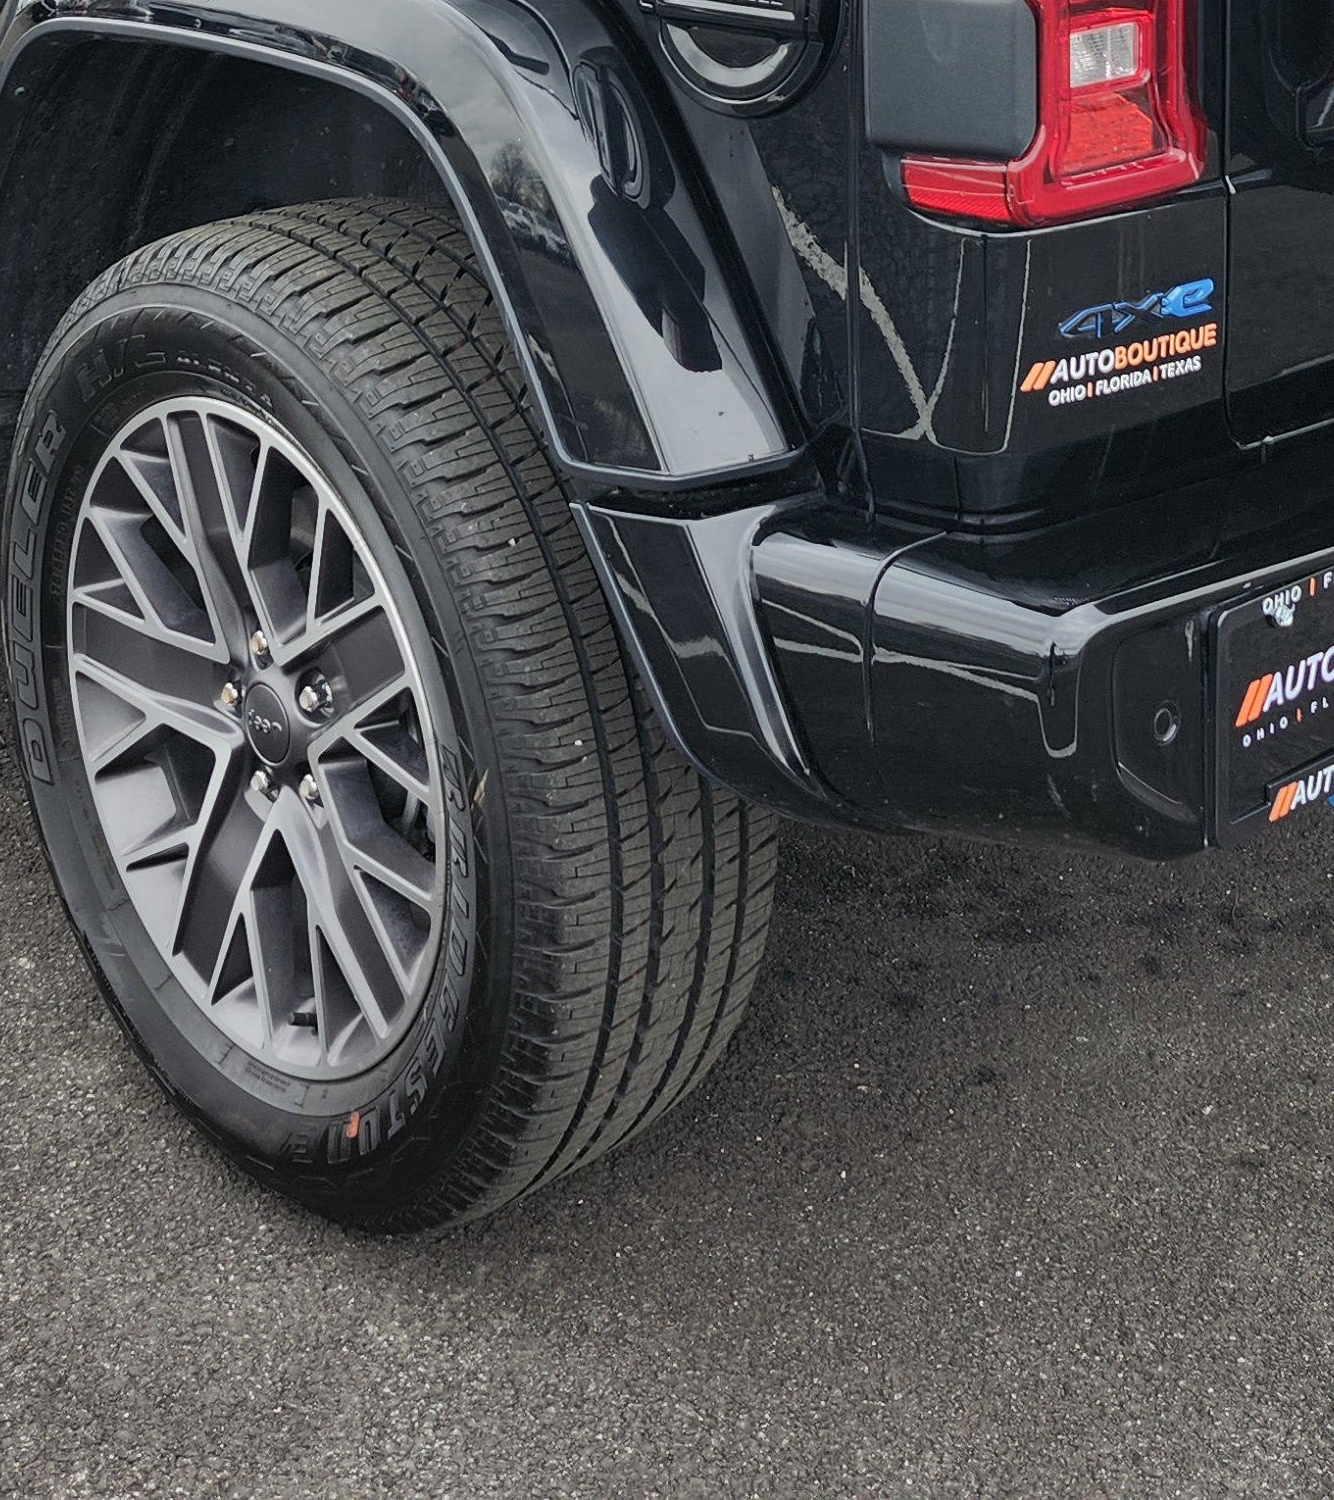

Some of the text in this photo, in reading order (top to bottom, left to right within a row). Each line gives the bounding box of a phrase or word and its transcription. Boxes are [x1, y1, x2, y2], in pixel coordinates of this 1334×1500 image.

[1048, 354, 1202, 407] OHIO FLORIDA TEXAS
[1049, 322, 1217, 385] AUTOBOUTIQUE
[10, 409, 67, 786] DUELER
[1262, 585, 1302, 615] OHIO
[1242, 716, 1289, 748] OHIO
[279, 742, 469, 1165] BRIDGESTONE
